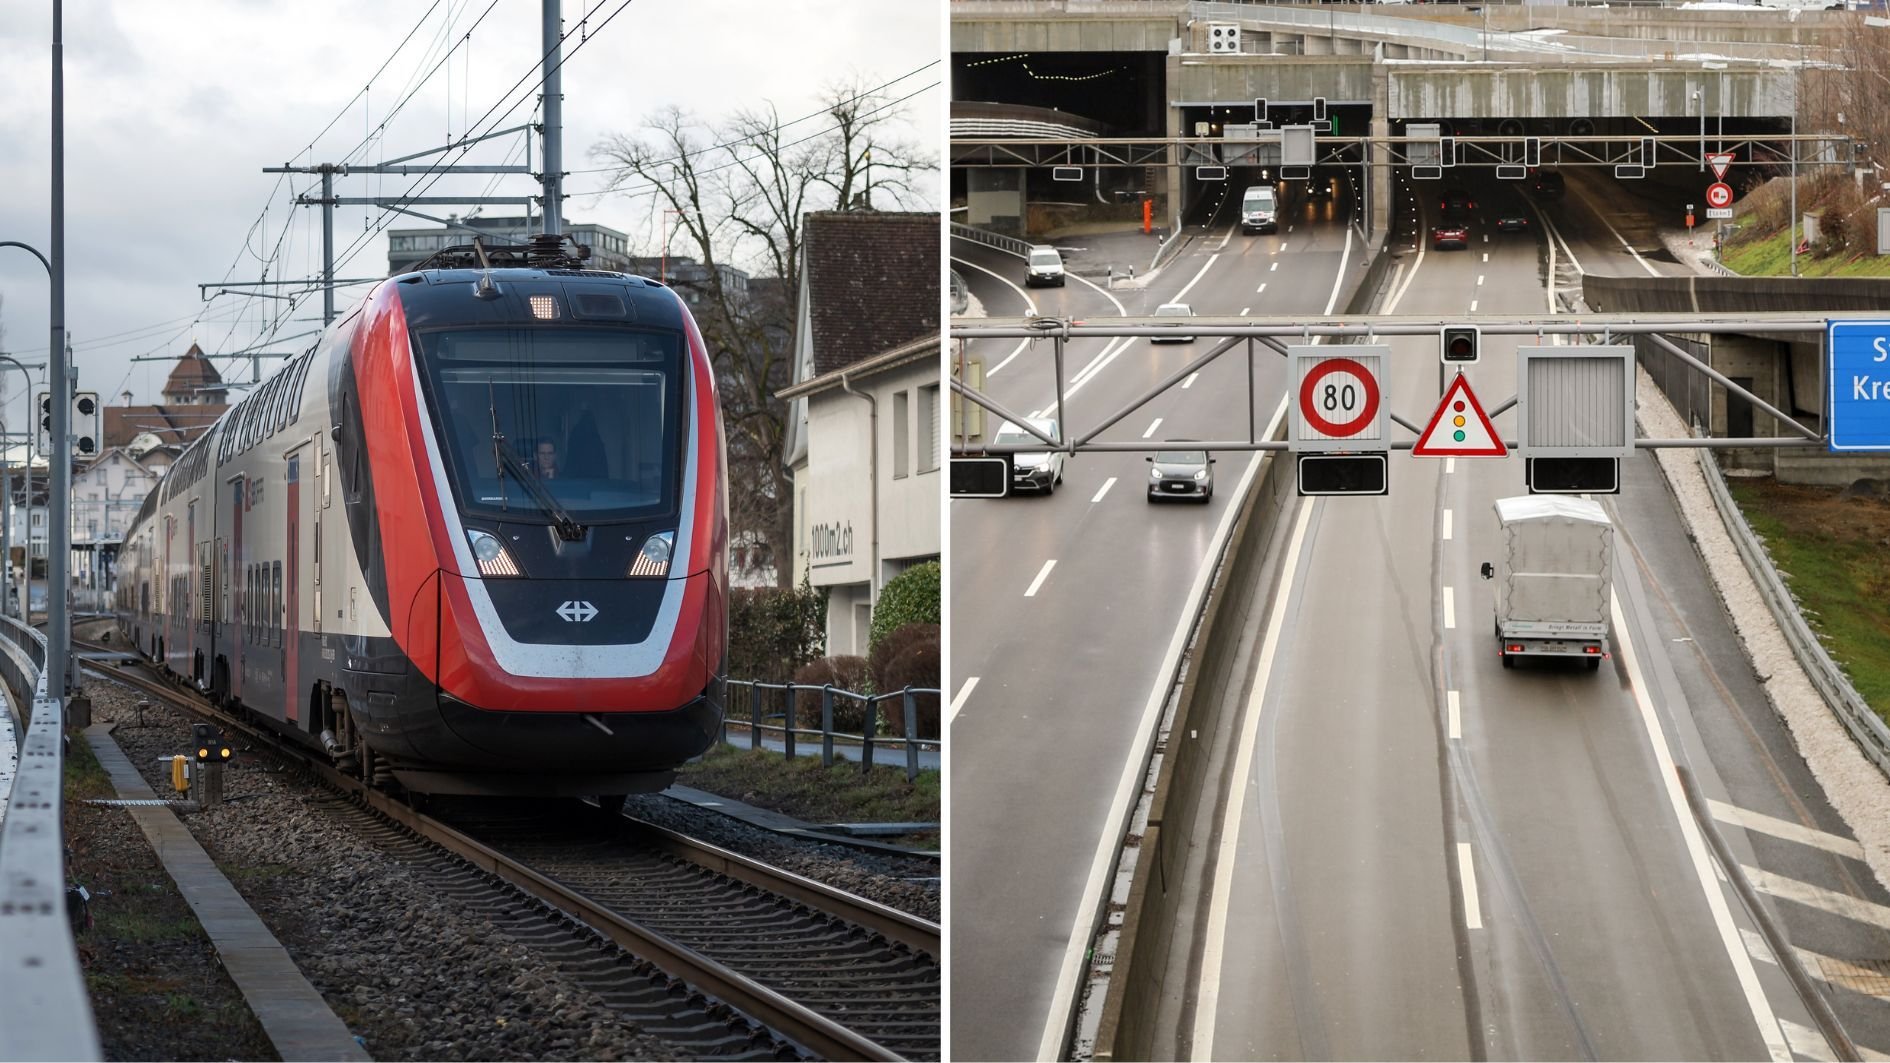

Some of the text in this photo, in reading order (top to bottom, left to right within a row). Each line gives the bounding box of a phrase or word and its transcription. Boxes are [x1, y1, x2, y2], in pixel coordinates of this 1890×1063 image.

[1873, 336, 1890, 362] S
[1324, 384, 1355, 411] 80
[811, 520, 853, 559] 1000m2.ch
